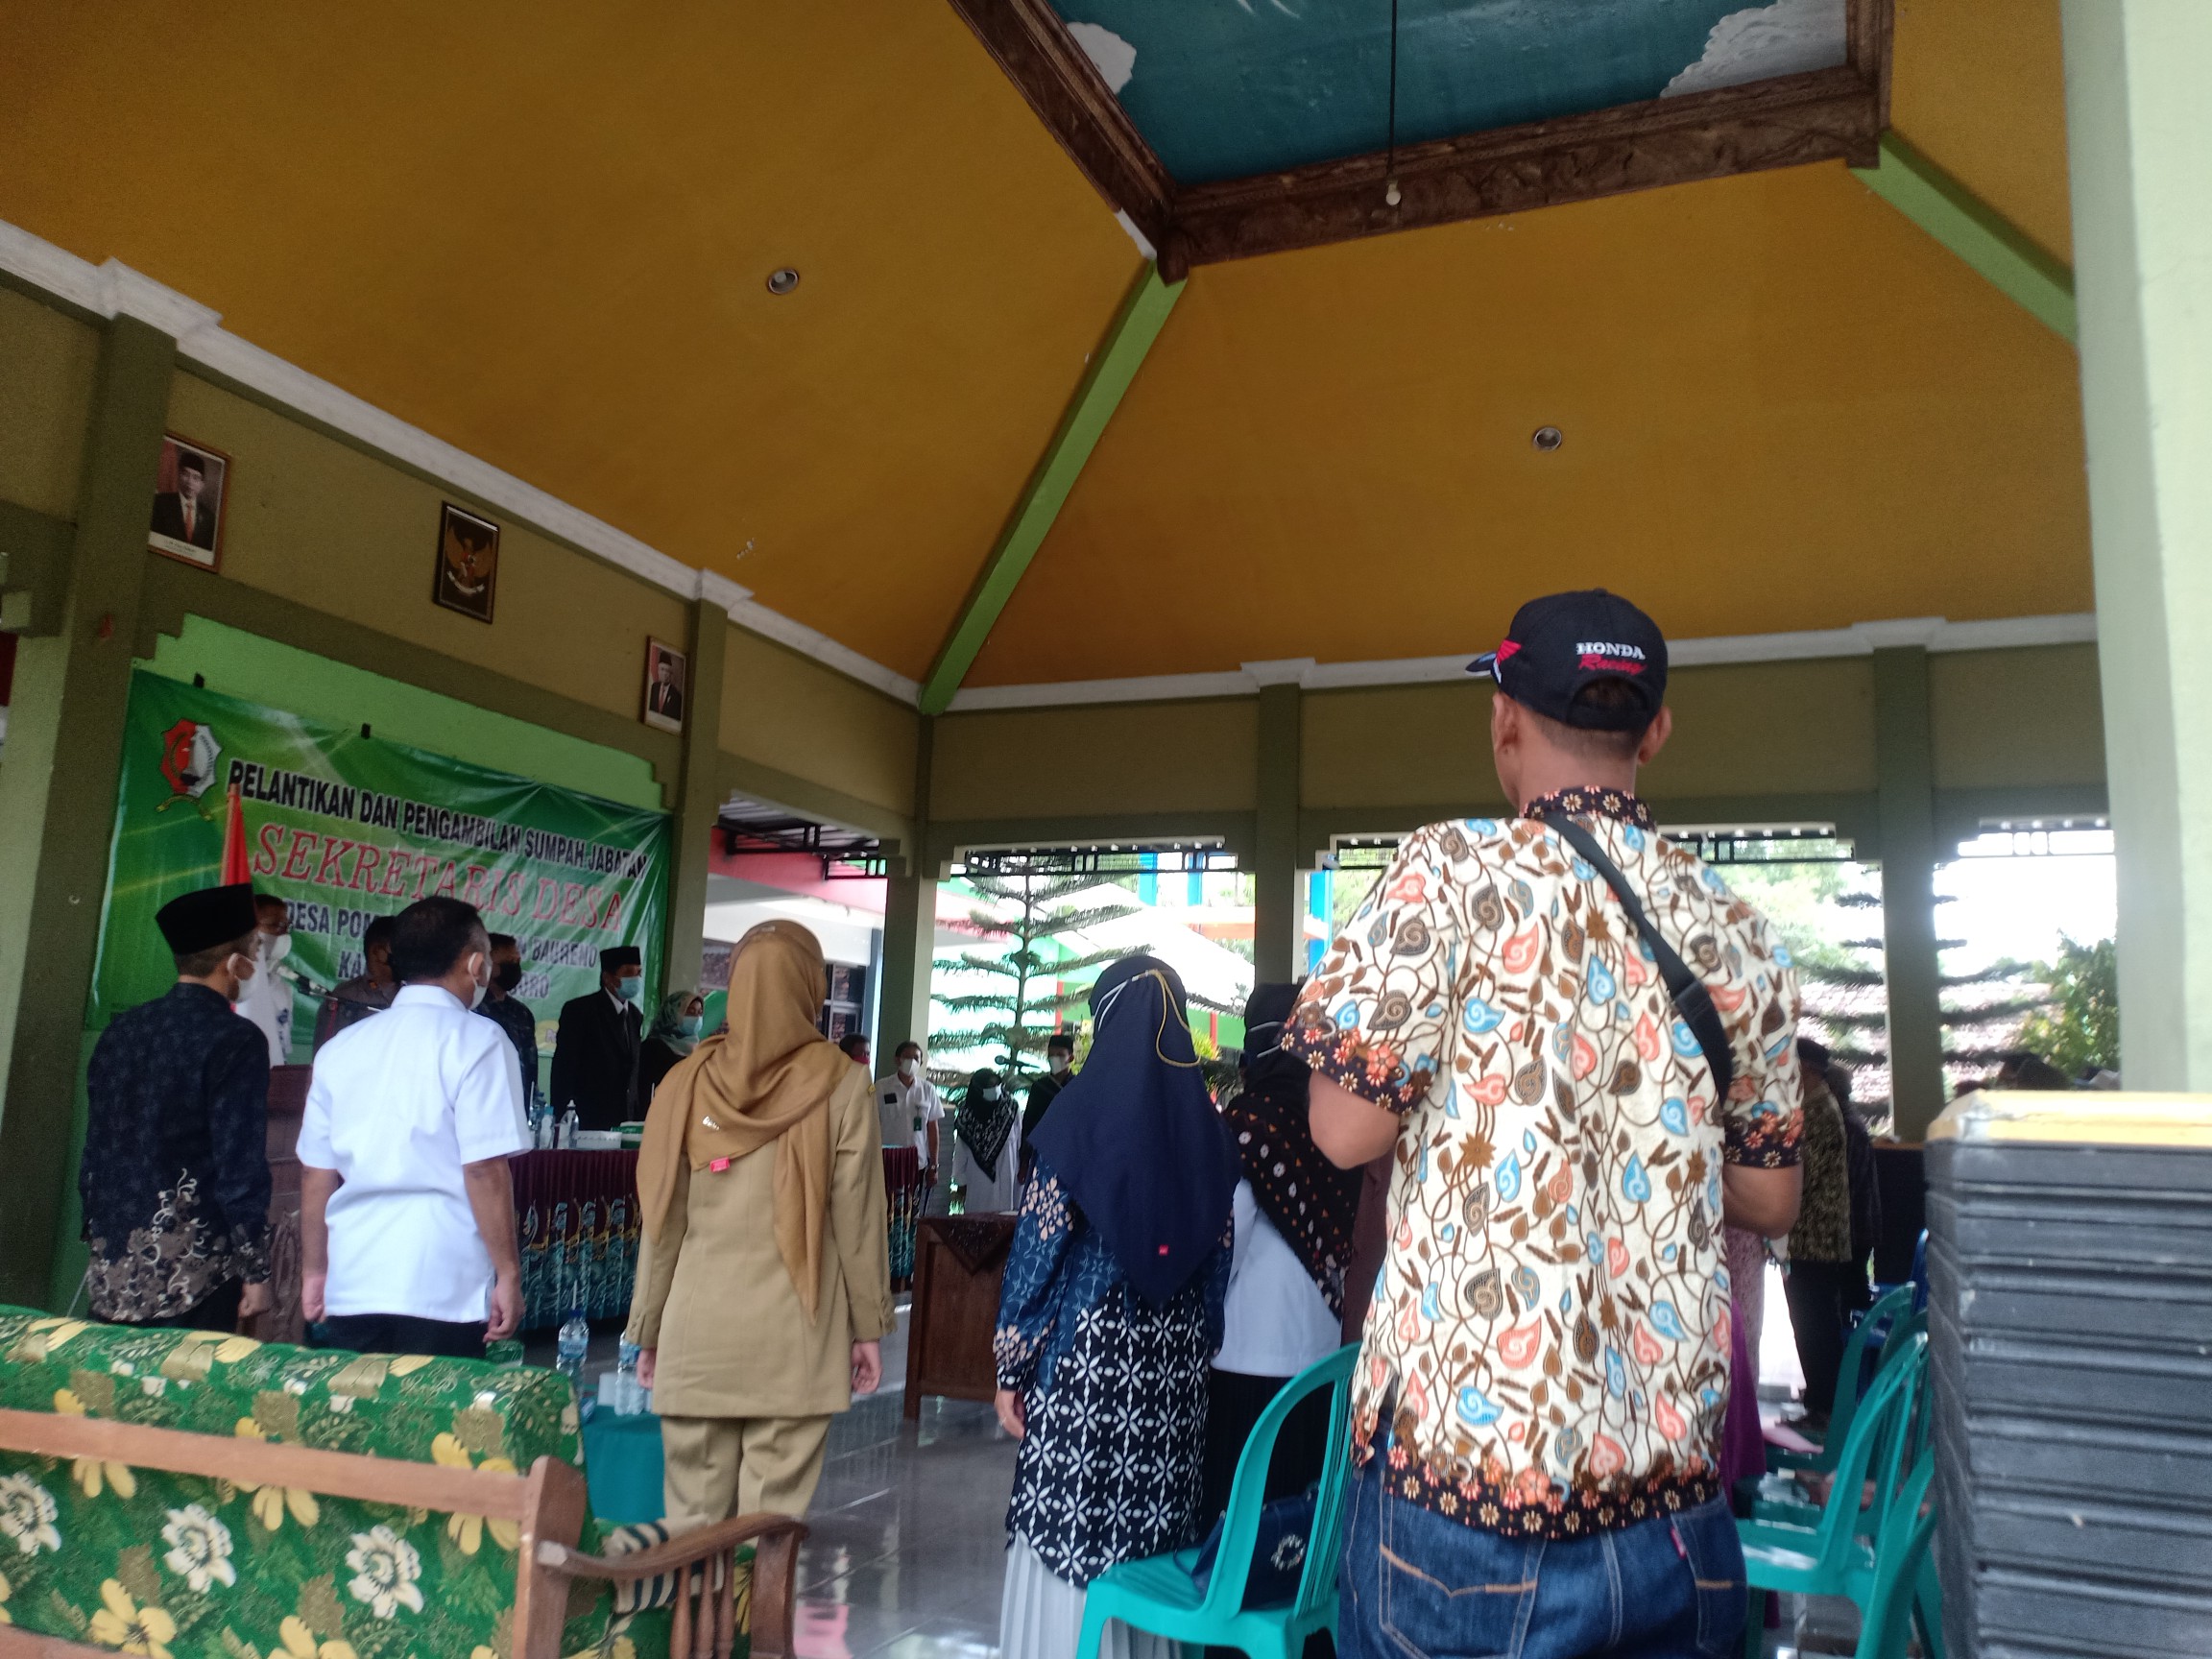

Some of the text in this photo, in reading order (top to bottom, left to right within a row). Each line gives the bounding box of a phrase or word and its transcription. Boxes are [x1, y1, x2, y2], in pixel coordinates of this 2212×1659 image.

[1575, 641, 1646, 660] HONDA
[228, 758, 356, 820] PELANTIKAN
[359, 789, 399, 830] DAN
[402, 800, 521, 854] PENGAMBILAN
[524, 828, 586, 868] SUMPAH
[588, 843, 649, 879] JABATAN
[252, 824, 622, 932] SEKRETARIS DESA
[286, 900, 330, 934] DESA
